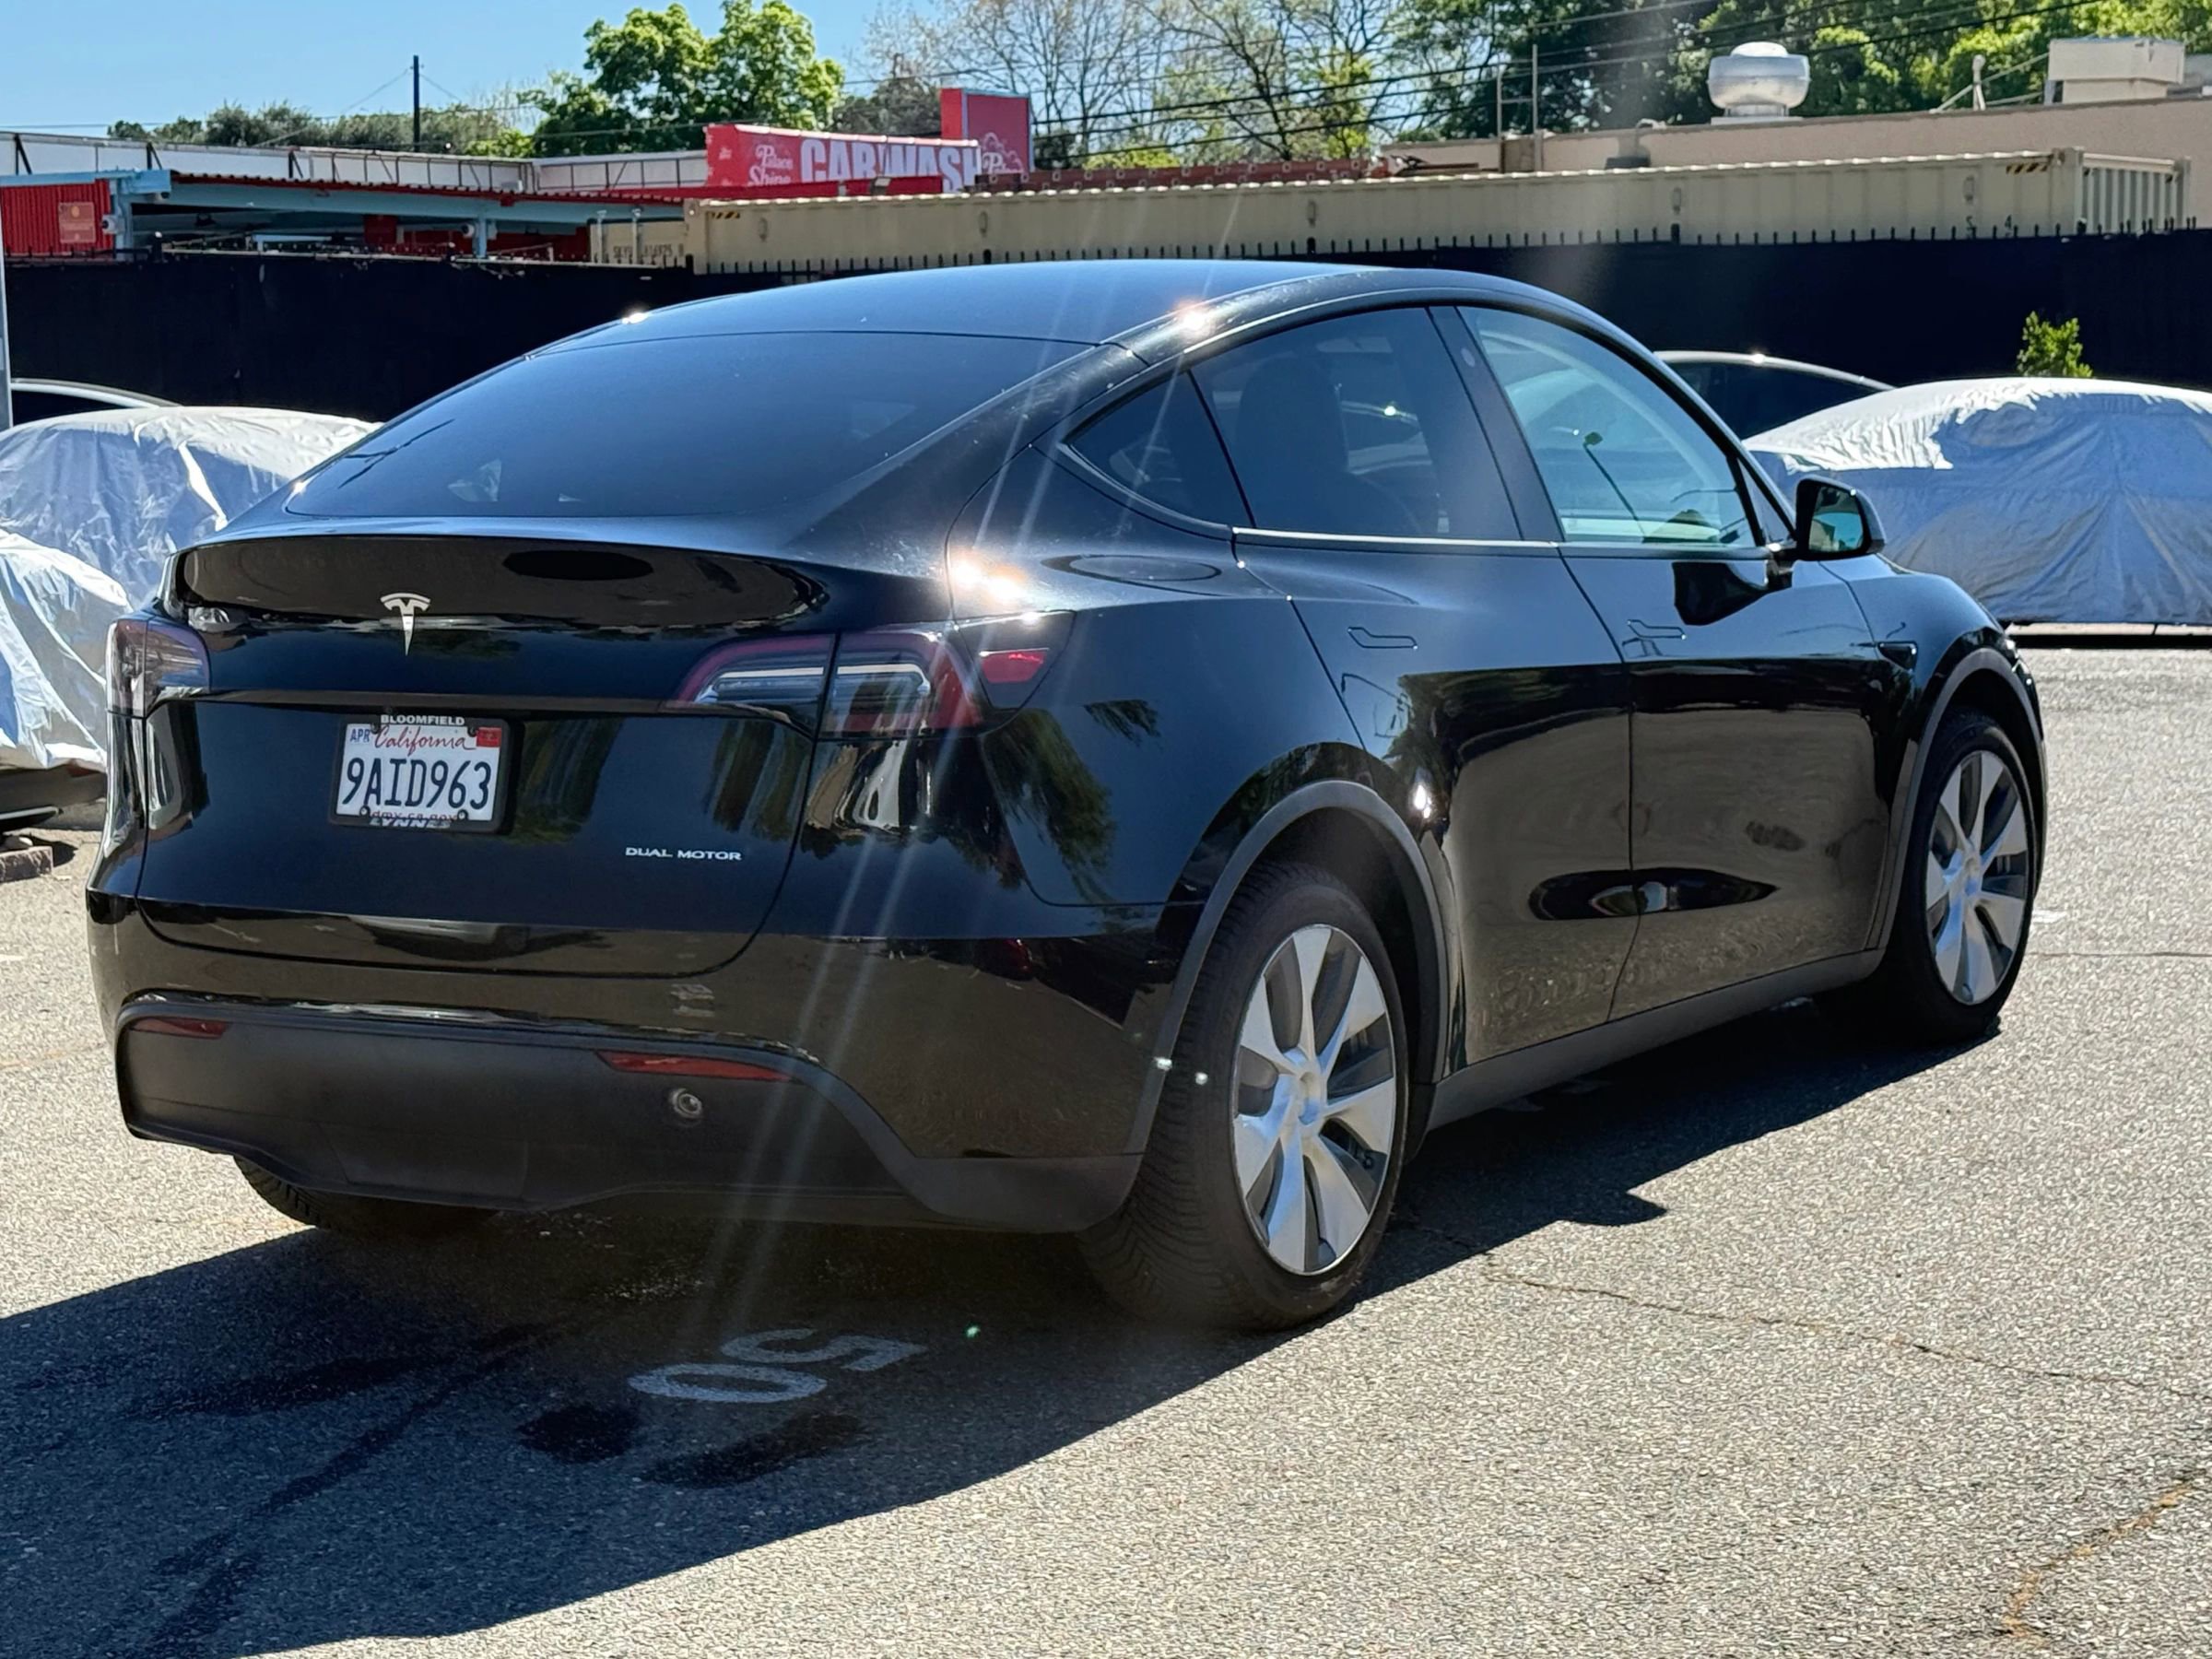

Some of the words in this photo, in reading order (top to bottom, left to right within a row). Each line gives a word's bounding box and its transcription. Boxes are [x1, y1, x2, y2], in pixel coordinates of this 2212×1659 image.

[800, 139, 875, 183] CAR
[876, 143, 981, 194] WASH
[381, 714, 465, 725] BLOOMFIELD
[350, 728, 371, 743] APR
[374, 726, 477, 757] California
[342, 758, 491, 810] 9AID963
[625, 847, 673, 857] DUAL
[677, 850, 742, 860] MOTOR
